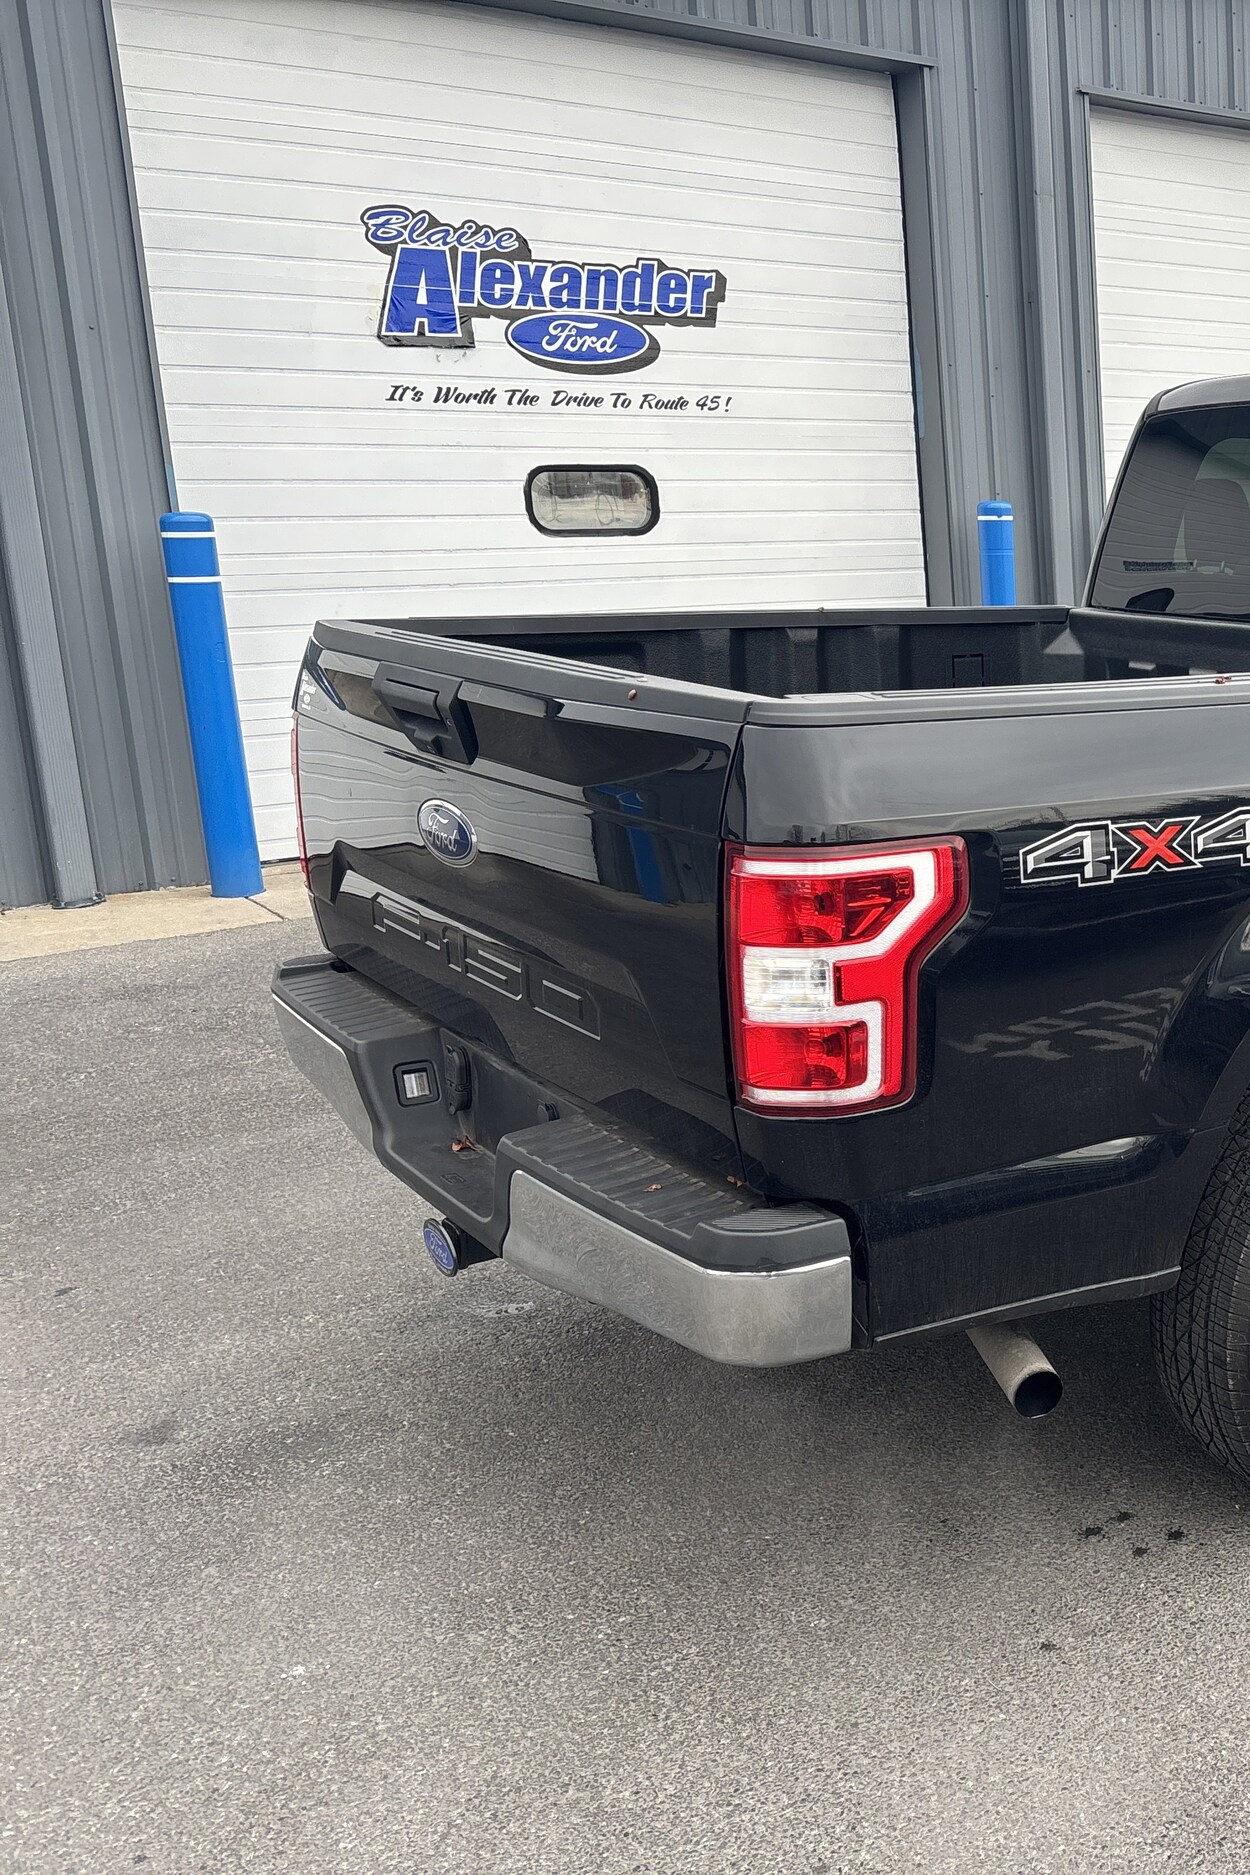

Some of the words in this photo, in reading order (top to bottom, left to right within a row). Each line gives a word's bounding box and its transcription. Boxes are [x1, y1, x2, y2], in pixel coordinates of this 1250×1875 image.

[363, 208, 519, 251] Blaise
[381, 245, 716, 337] Alexander
[541, 319, 619, 353] Ford
[385, 384, 424, 403] It's
[433, 385, 498, 405] Worth
[503, 388, 541, 407] The
[550, 390, 605, 408] Drive
[609, 392, 632, 409] To
[639, 393, 690, 411] Route
[426, 811, 459, 853] Ford
[371, 891, 601, 1041] F-150
